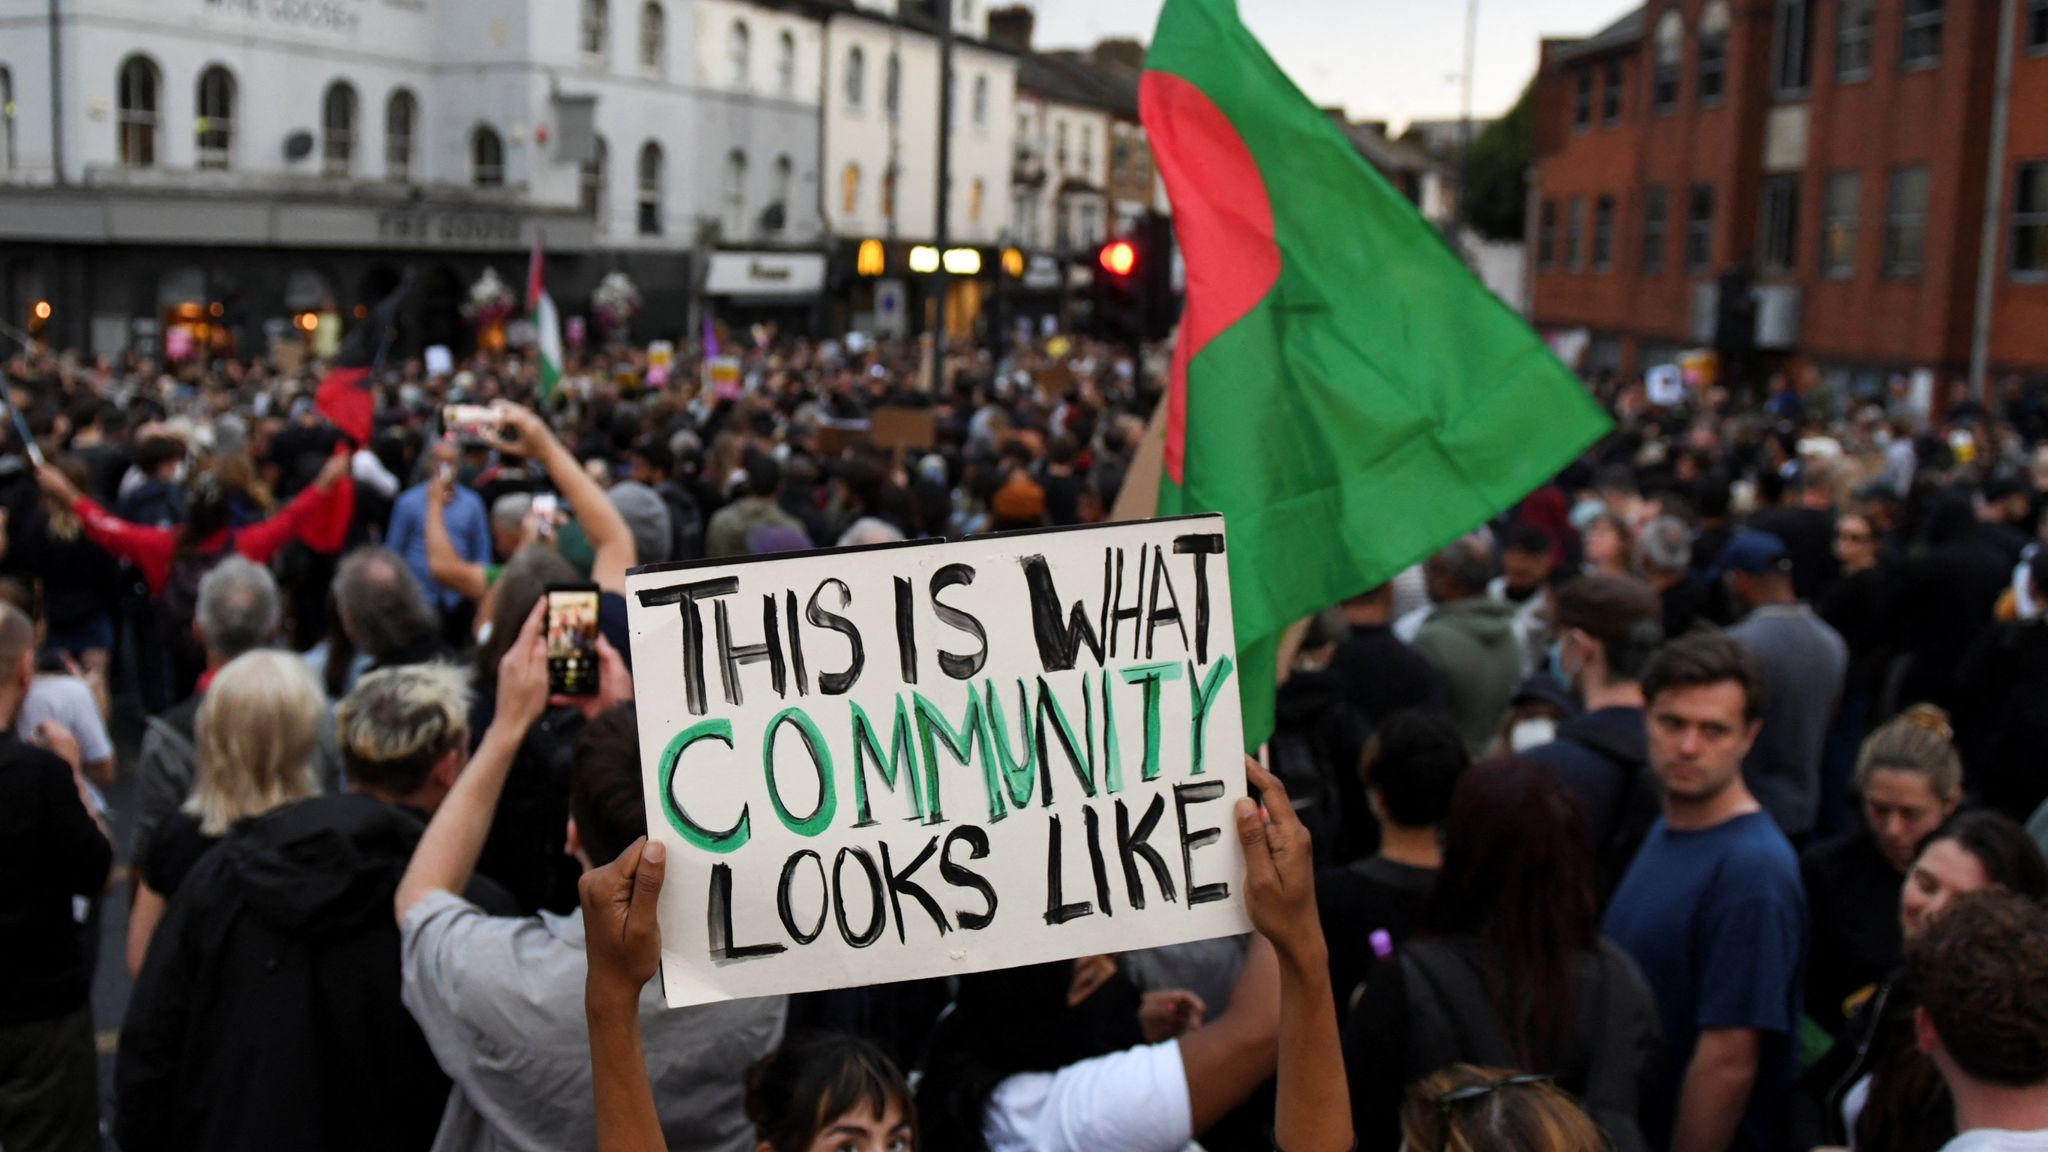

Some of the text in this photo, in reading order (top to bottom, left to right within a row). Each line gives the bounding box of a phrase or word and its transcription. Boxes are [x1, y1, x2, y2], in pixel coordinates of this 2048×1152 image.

[635, 533, 1225, 716] THIS IS WHAT
[657, 653, 1234, 854] COMMUNITY
[707, 779, 1232, 968] LOOKS LIKE
